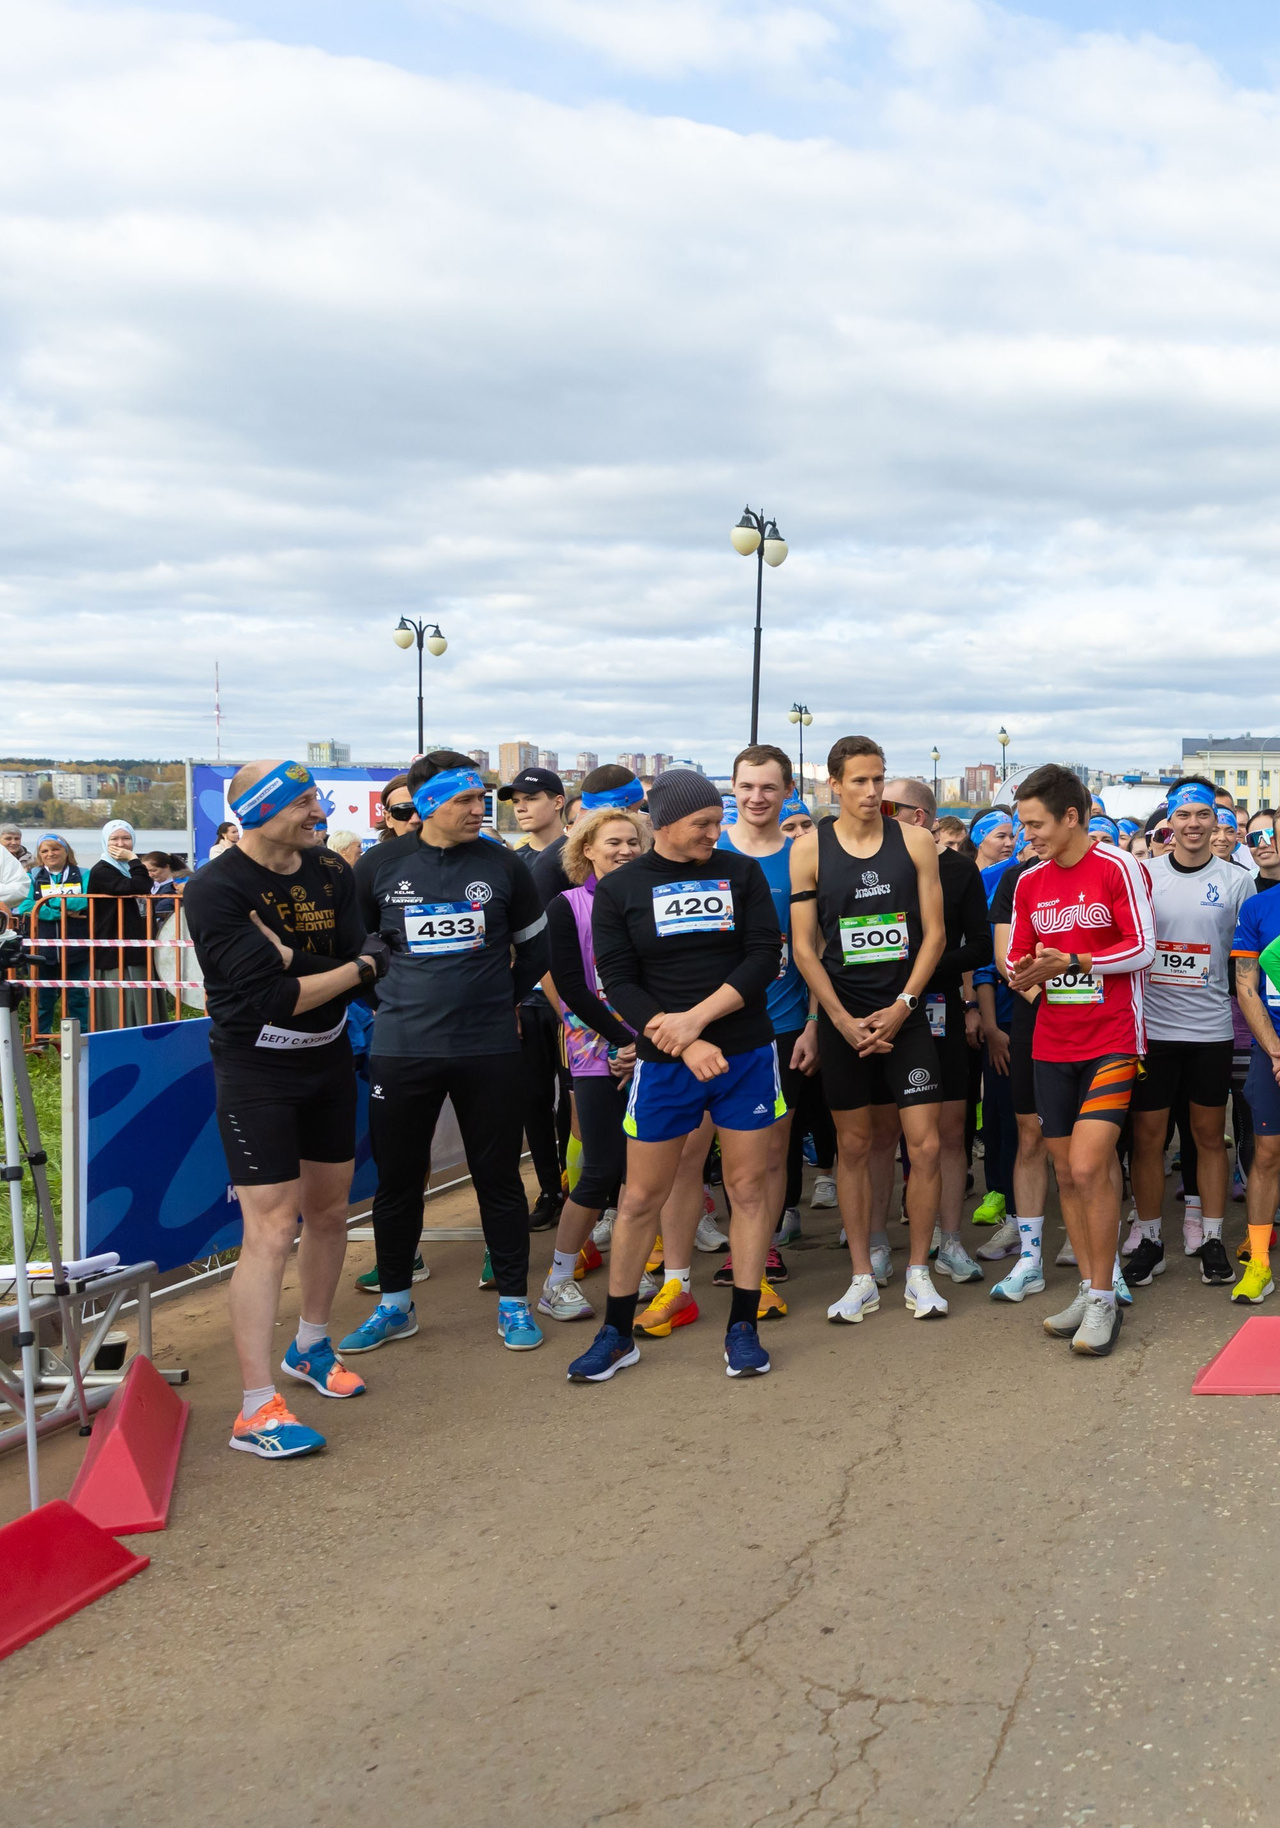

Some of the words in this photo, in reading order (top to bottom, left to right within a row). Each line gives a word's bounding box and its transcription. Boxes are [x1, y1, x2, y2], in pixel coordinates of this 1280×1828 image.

[294, 901, 316, 912] DAY
[665, 896, 724, 917] 420
[1037, 900, 1056, 909] BOSCO
[418, 917, 475, 938] 433
[851, 929, 902, 949] 500
[1161, 953, 1196, 969] 194
[1051, 973, 1095, 988] 504
[260, 1032, 290, 1044] БЕГУ
[903, 1083, 938, 1095] INSANITY
